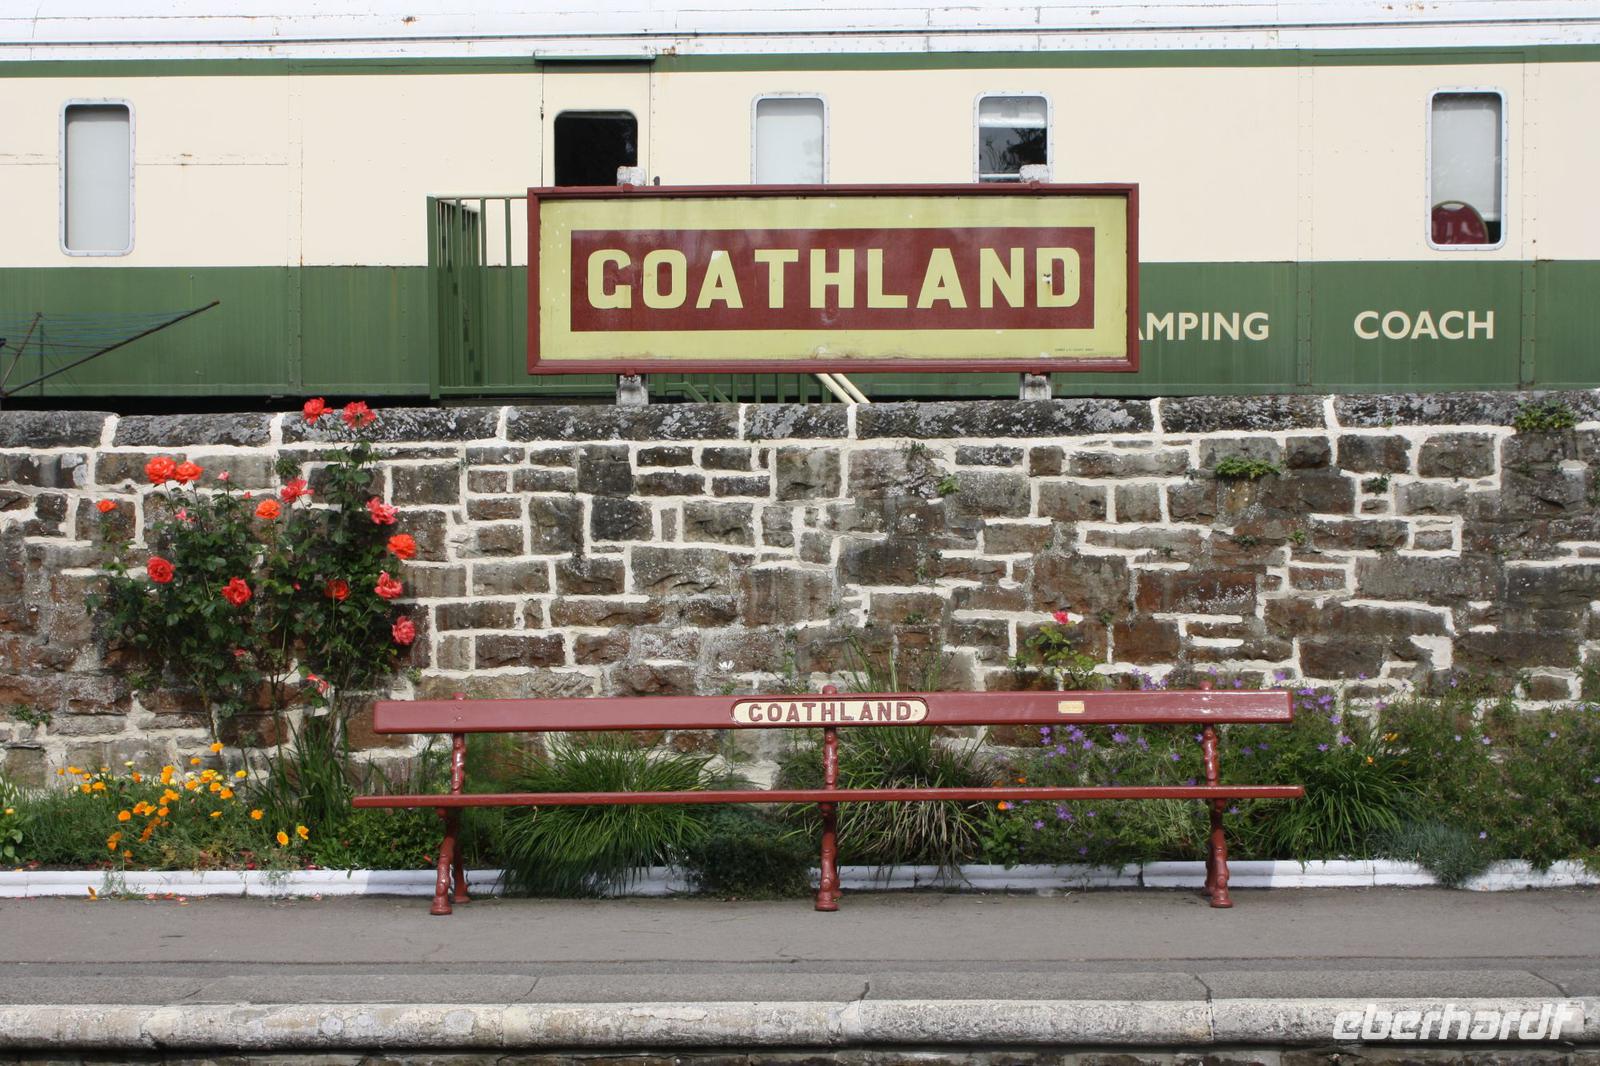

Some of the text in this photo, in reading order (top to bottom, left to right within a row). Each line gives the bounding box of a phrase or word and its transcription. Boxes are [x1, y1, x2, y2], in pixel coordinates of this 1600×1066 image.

[587, 247, 1081, 309] GOATHLAND
[1138, 310, 1494, 341] MPING COACH
[748, 702, 912, 722] GOATHLAND
